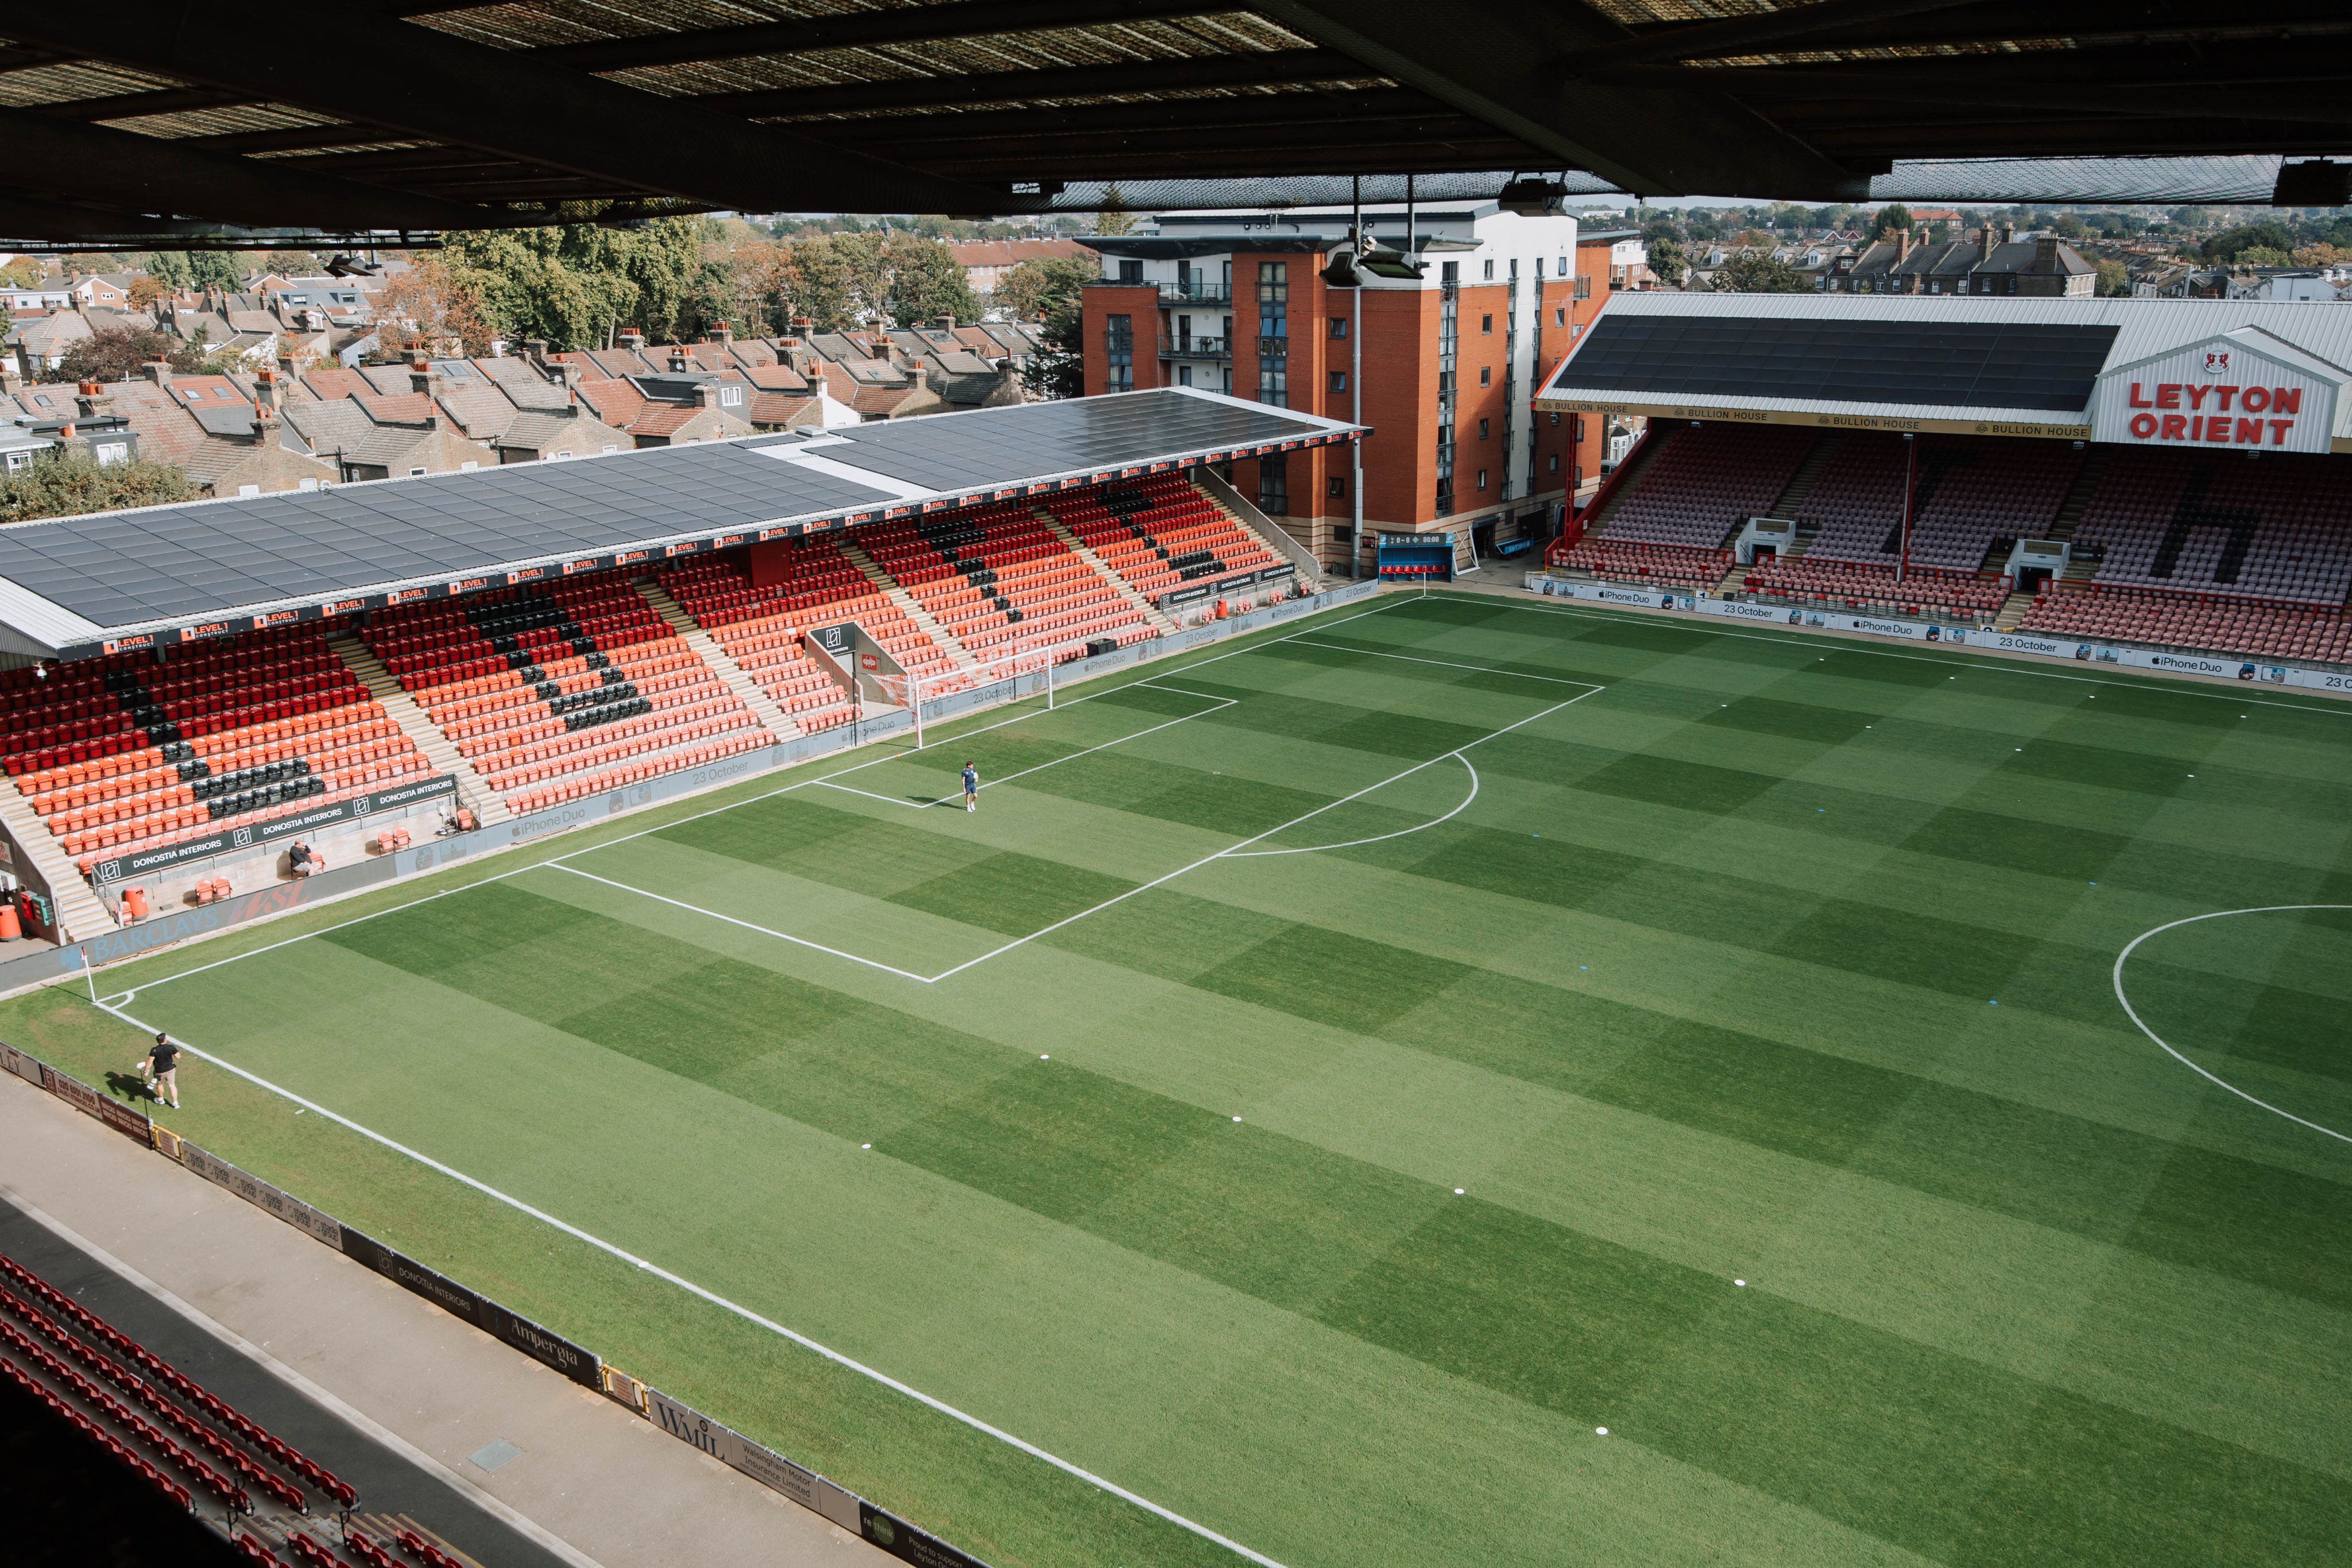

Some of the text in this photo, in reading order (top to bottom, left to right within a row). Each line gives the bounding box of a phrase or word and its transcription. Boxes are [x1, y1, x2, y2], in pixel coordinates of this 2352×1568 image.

[2129, 382, 2301, 414] LEYTON
[1555, 403, 1627, 413] BULLION HOUSE
[1688, 409, 1767, 420] BULLION HOUSE
[1833, 417, 1920, 429] BULLION HOUSE
[2130, 413, 2294, 445] ORIENT
[1993, 425, 2087, 436] BULLION HOUSE
[930, 501, 944, 509] LEVEL
[768, 528, 785, 536] LEVEL
[722, 535, 740, 543] LEVEL
[675, 543, 693, 551] LEVEL
[625, 551, 644, 560] LEVEL
[573, 560, 593, 569] LEVEL
[573, 564, 597, 573] CONSTRUCT
[518, 570, 539, 578] LEVEL
[519, 572, 544, 582] CONSTRUCT
[460, 579, 482, 589] LEVEL
[461, 582, 487, 593] CONSTRUCT
[399, 589, 423, 599] LEVEL
[400, 593, 428, 603] CONSTRUCT
[1346, 585, 1372, 598] 23 October
[1606, 591, 1650, 603] iPhone Duo
[334, 600, 360, 610] LEVEL
[335, 603, 365, 614] CONSTRUCT
[1275, 604, 1303, 618] iPhone Duo
[1724, 605, 1773, 618] 23 October
[266, 611, 293, 622] LEVEL
[266, 615, 298, 627] CONSTRUCT
[194, 624, 222, 634] LEVEL
[195, 628, 228, 640] CONSTRUCT
[1860, 621, 1912, 635] iPhone Duo
[118, 636, 148, 647] LEVEL
[1186, 629, 1217, 644] 23 October
[119, 640, 154, 652] CONSTRUCT
[1999, 637, 2057, 652] 23 October
[1089, 655, 1125, 671] iPhone Duo
[2160, 657, 2222, 673] iPhone Duo
[2326, 676, 2342, 688] 23
[973, 686, 1016, 704] 23 October
[878, 721, 895, 731] Duo
[693, 761, 749, 785] 23 October
[380, 780, 452, 804] DONOSTIA INTERIORS
[263, 808, 343, 835] DONOSTIA INTERIORS
[521, 809, 585, 835] iPhone Duo
[133, 839, 222, 868] DONOSTIA INTERIORS
[230, 880, 311, 922] WSL
[94, 907, 219, 961] BARCLAYS
[59, 1079, 69, 1091] 020
[70, 1085, 81, 1097] 8501
[82, 1091, 95, 1105] 2100
[101, 1101, 115, 1114] BRICKS
[116, 1109, 131, 1122] BRICKS
[103, 1109, 117, 1122] BRICKS
[118, 1117, 133, 1130] BRICKS
[189, 1152, 205, 1164] stadia
[190, 1159, 206, 1171] group
[214, 1165, 230, 1178] stadia
[215, 1172, 230, 1184] group
[241, 1179, 257, 1192] stadia
[241, 1186, 257, 1198] group
[265, 1193, 283, 1206] stadia
[266, 1199, 283, 1212] group
[293, 1207, 311, 1221] stadia
[295, 1215, 311, 1228] group
[321, 1222, 338, 1236] stadia
[322, 1229, 338, 1242] group
[435, 1286, 471, 1311] INTERIORS
[512, 1319, 578, 1368] Ampergia
[655, 1400, 725, 1461] WMIL
[743, 1443, 811, 1487] Walsingham Motor
[745, 1455, 810, 1497] Insurance Limited
[909, 1536, 927, 1554] Proud
[929, 1548, 936, 1557] to
[937, 1552, 962, 1568] support
[914, 1548, 937, 1567] Leyton
